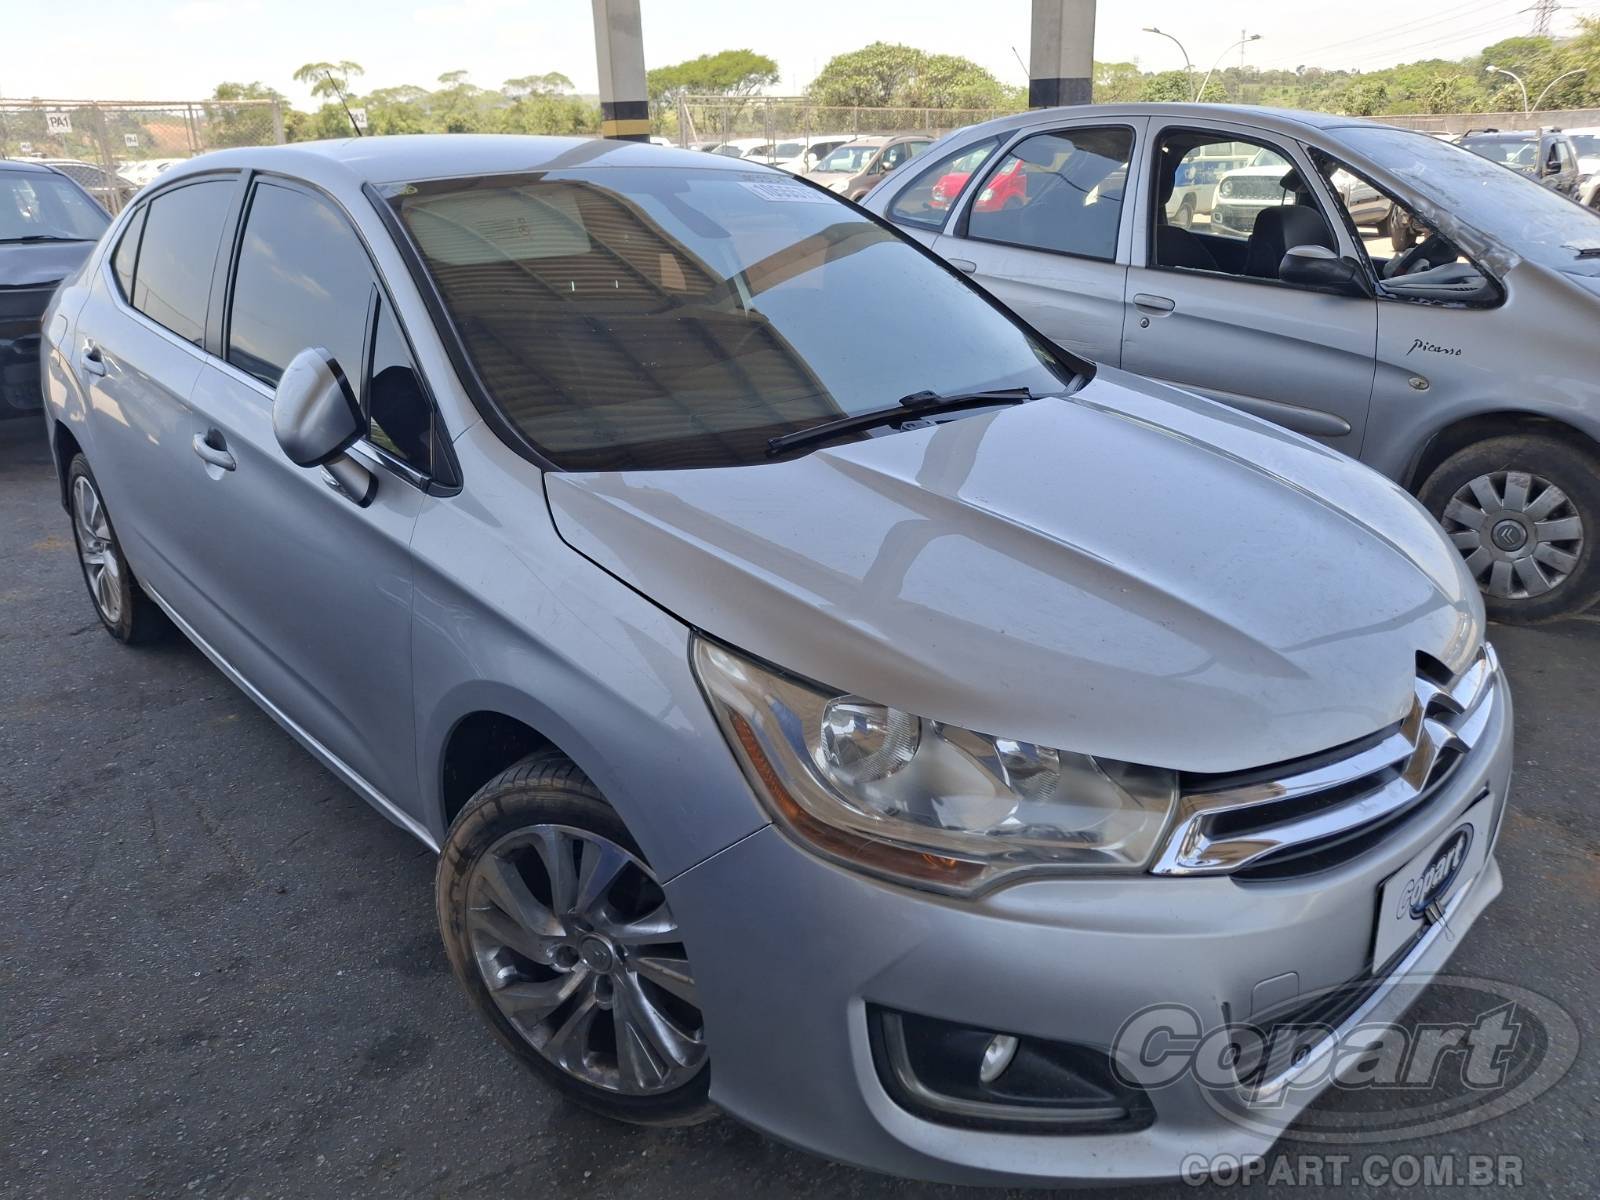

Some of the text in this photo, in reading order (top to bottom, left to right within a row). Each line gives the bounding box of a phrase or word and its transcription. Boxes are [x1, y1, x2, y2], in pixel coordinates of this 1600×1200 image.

[50, 116, 70, 129] PA1
[1406, 338, 1462, 356] Picasso
[1396, 834, 1465, 920] Copart
